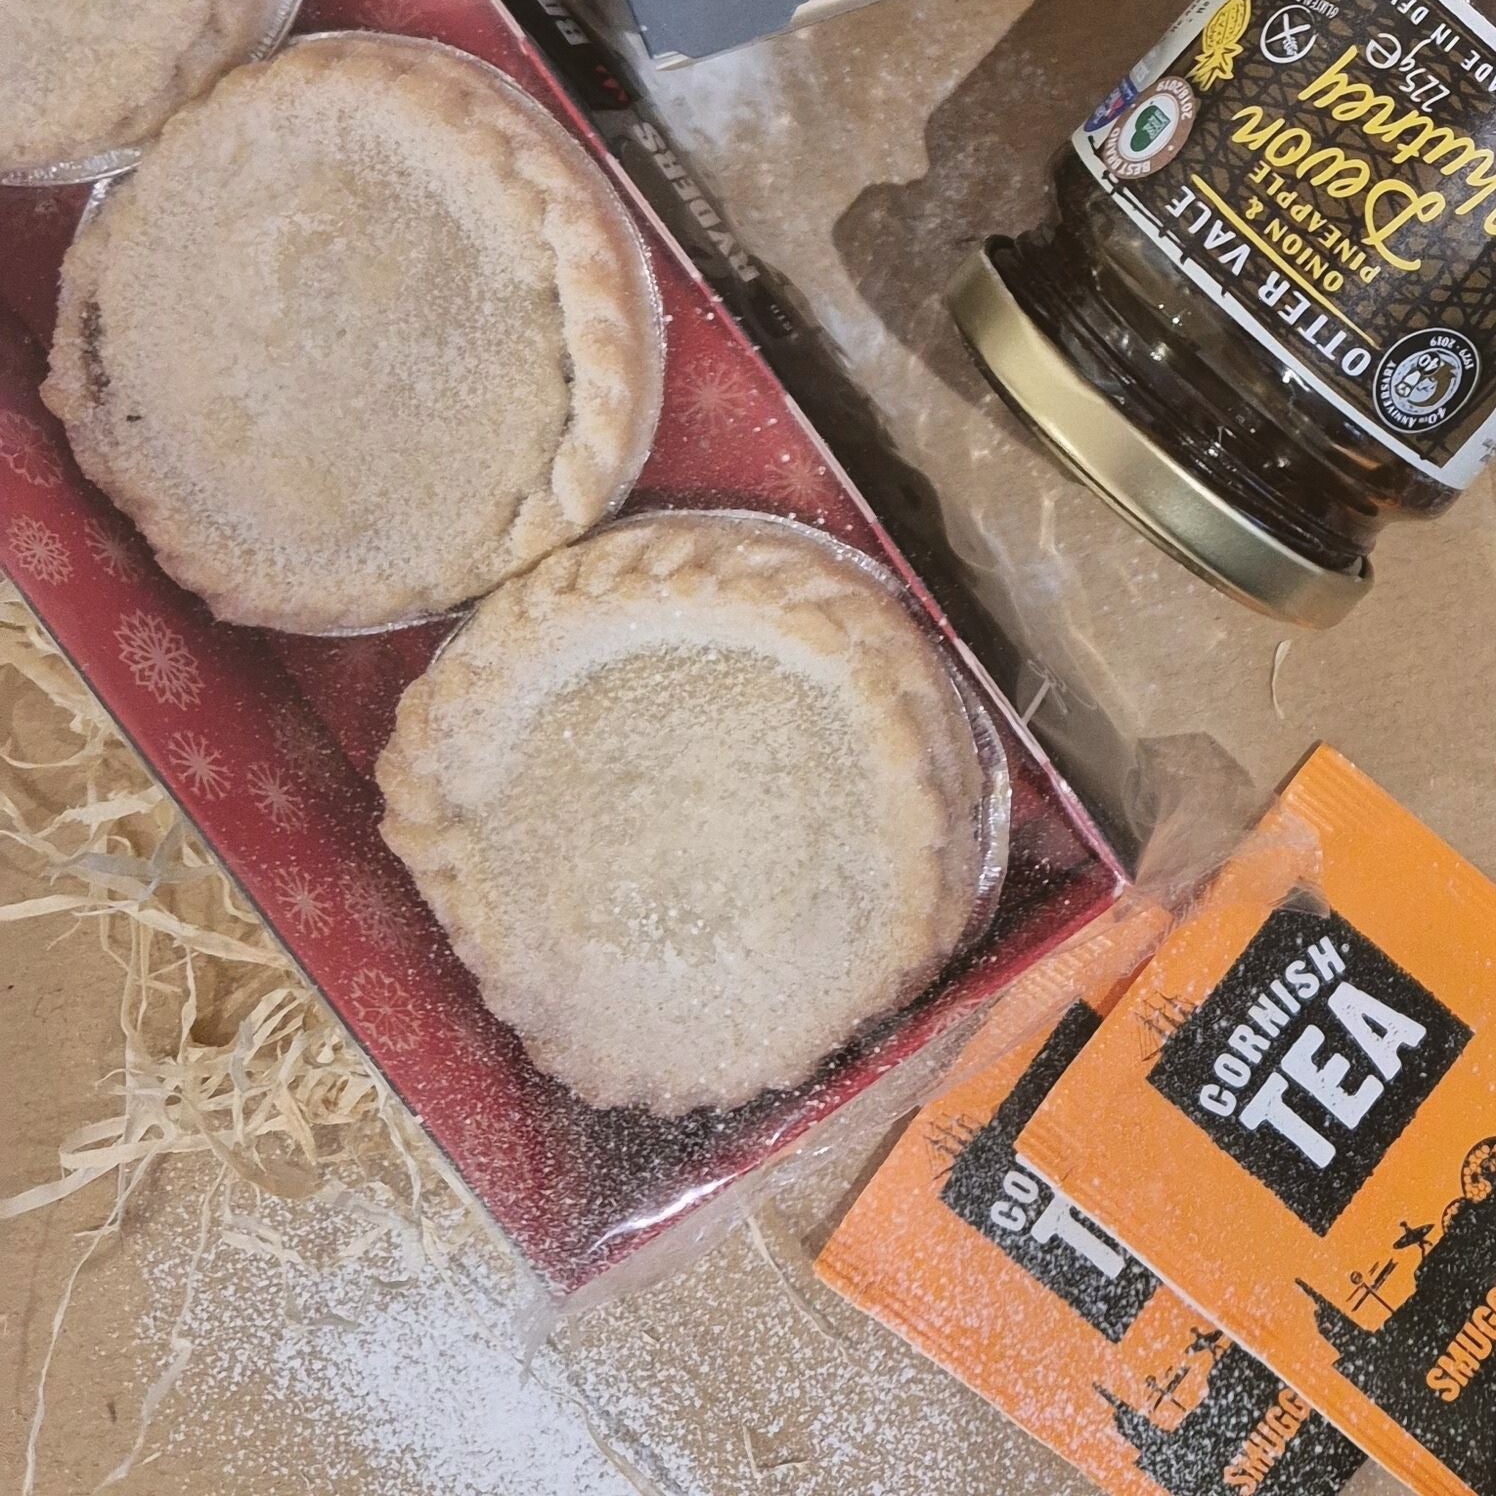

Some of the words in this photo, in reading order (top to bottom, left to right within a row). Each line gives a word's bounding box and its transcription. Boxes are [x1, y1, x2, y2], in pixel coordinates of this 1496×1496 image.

[1430, 22, 1460, 53] IN
[632, 121, 761, 283] RYDERS
[1117, 161, 1151, 176] BEST
[1231, 105, 1446, 271] Devon
[1244, 195, 1264, 220] &
[1164, 185, 1251, 277] VALE
[1248, 159, 1381, 285] PINEAPPLE
[1264, 218, 1345, 292] ONION
[1257, 270, 1371, 377] OTTER
[1418, 353, 1440, 372] 40
[1429, 335, 1457, 349] 2019
[1380, 359, 1417, 428] ANNIVERSARY
[1199, 935, 1348, 1117] CORNISH
[1239, 981, 1427, 1170] TEA
[1223, 1387, 1311, 1496] SMUGG
